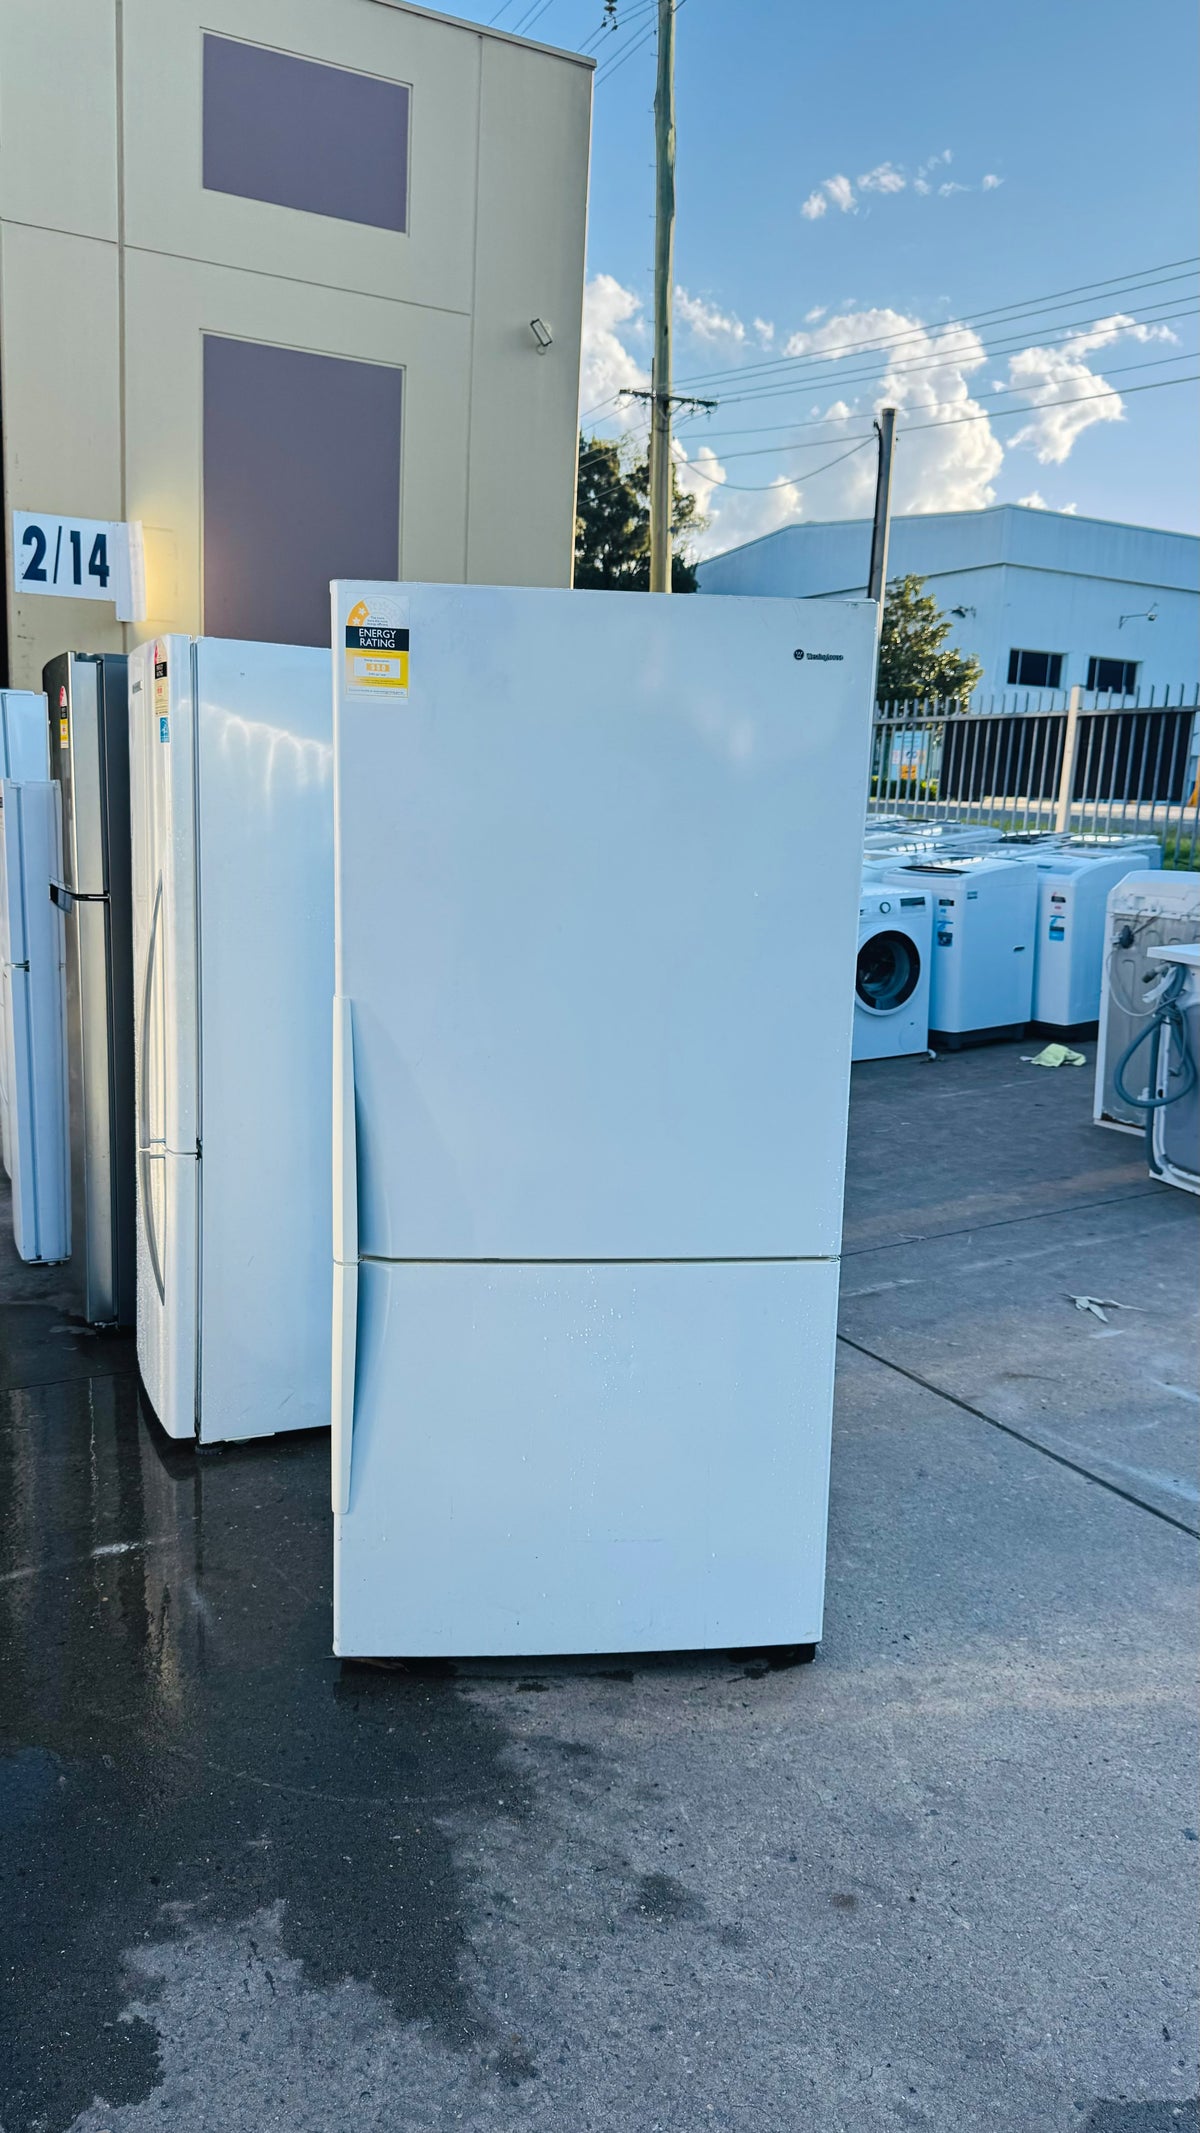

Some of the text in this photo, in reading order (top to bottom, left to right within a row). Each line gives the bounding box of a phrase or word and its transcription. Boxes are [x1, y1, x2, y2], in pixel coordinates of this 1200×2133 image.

[22, 525, 110, 588] 2/14
[359, 628, 396, 638] ENERGY
[360, 638, 396, 648] RATING
